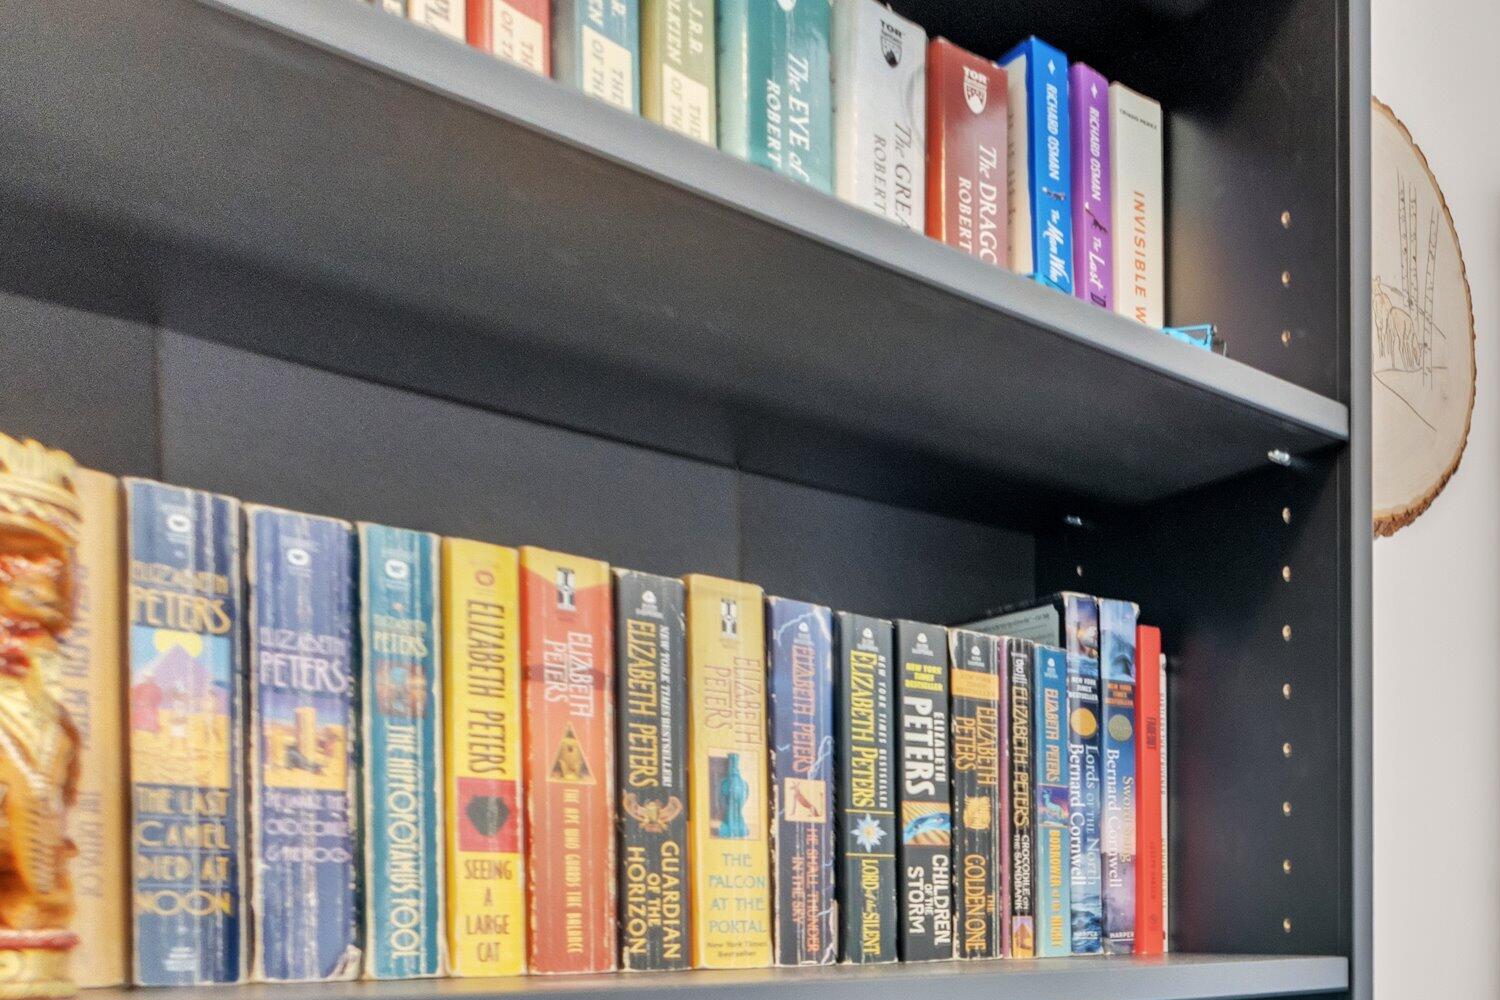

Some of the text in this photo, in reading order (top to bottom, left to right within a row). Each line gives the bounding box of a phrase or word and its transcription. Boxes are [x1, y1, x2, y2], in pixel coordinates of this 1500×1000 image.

[881, 20, 902, 38] TOR
[767, 79, 782, 168] ROBERT
[789, 94, 810, 151] EYE
[979, 144, 997, 180] The
[1047, 83, 1061, 181] RICHARD OSMAN
[1088, 106, 1102, 202] RICHARD OSMAN
[874, 133, 888, 216] ROBERT
[959, 176, 973, 254] ROBERT
[1133, 190, 1147, 298] INVISIBLE
[466, 600, 506, 775] ELIZABETH PETERS
[544, 638, 568, 703] PETERS
[567, 632, 595, 718] ELIZABETH
[660, 625, 673, 683] NEW YORK
[626, 619, 658, 788] ELIZABETH PETERS
[704, 663, 732, 730] PETERS
[734, 656, 763, 745] ELIZABETH
[850, 650, 879, 808] ELIZABETH PETERS
[903, 696, 934, 796] PETERS
[933, 711, 946, 783] ELIZABETH
[976, 706, 999, 786] ELIZABETH
[1068, 742, 1085, 887] Bernard Cornwell
[1085, 744, 1099, 886] Lords North
[1107, 748, 1121, 888] Bernard Cornwell
[464, 859, 513, 881] SEEING
[627, 845, 647, 955] HORIZON
[647, 872, 661, 927] OF THE
[662, 840, 681, 959] GUARDIAN
[708, 874, 766, 888] FALCON
[710, 897, 767, 911] AT THE
[862, 859, 881, 955] LORD SILENT
[906, 866, 924, 934] STORM
[931, 854, 951, 946] CHILDREN
[963, 854, 988, 913] GOLDEN
[389, 898, 420, 959] POOL
[465, 915, 511, 936] LARGE
[475, 943, 502, 963] CAT
[708, 921, 767, 934] PORTAL
